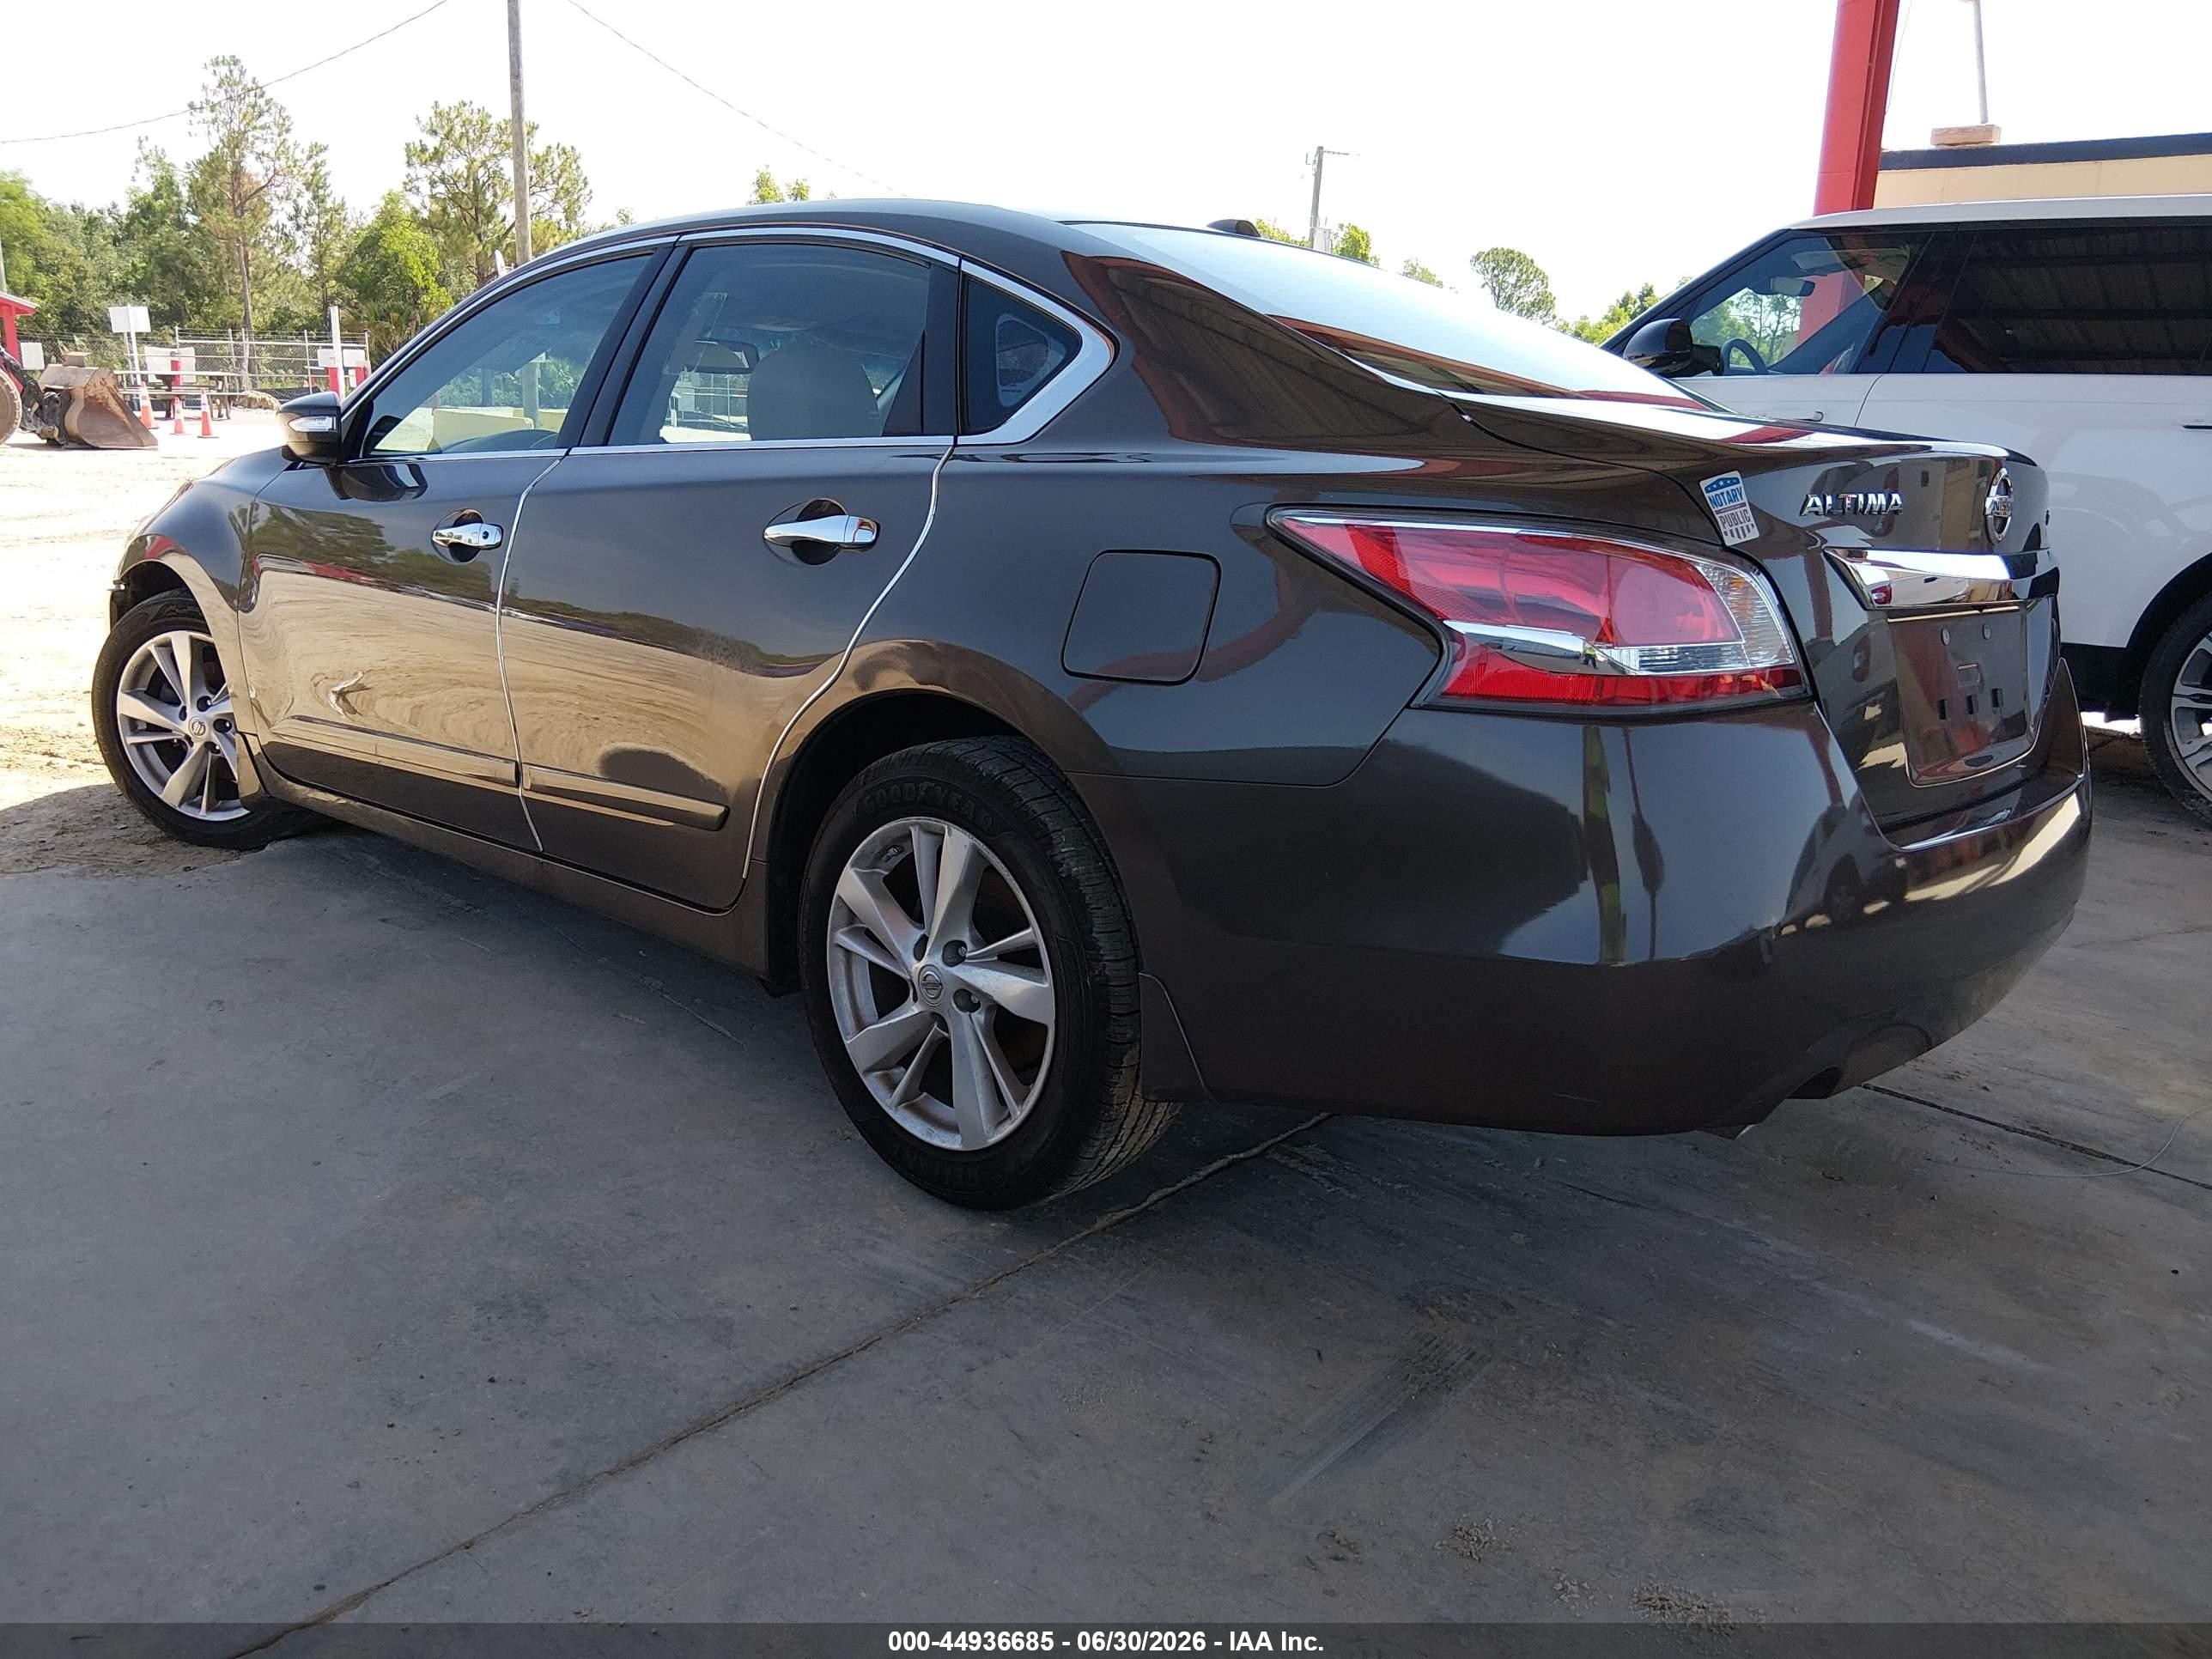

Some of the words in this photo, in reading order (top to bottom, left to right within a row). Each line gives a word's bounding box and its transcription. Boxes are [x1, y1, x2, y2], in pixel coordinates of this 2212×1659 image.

[1708, 486, 1743, 509] NOTARY
[1800, 493, 1904, 516] ALTIMA
[1718, 508, 1752, 530] PUBLIC
